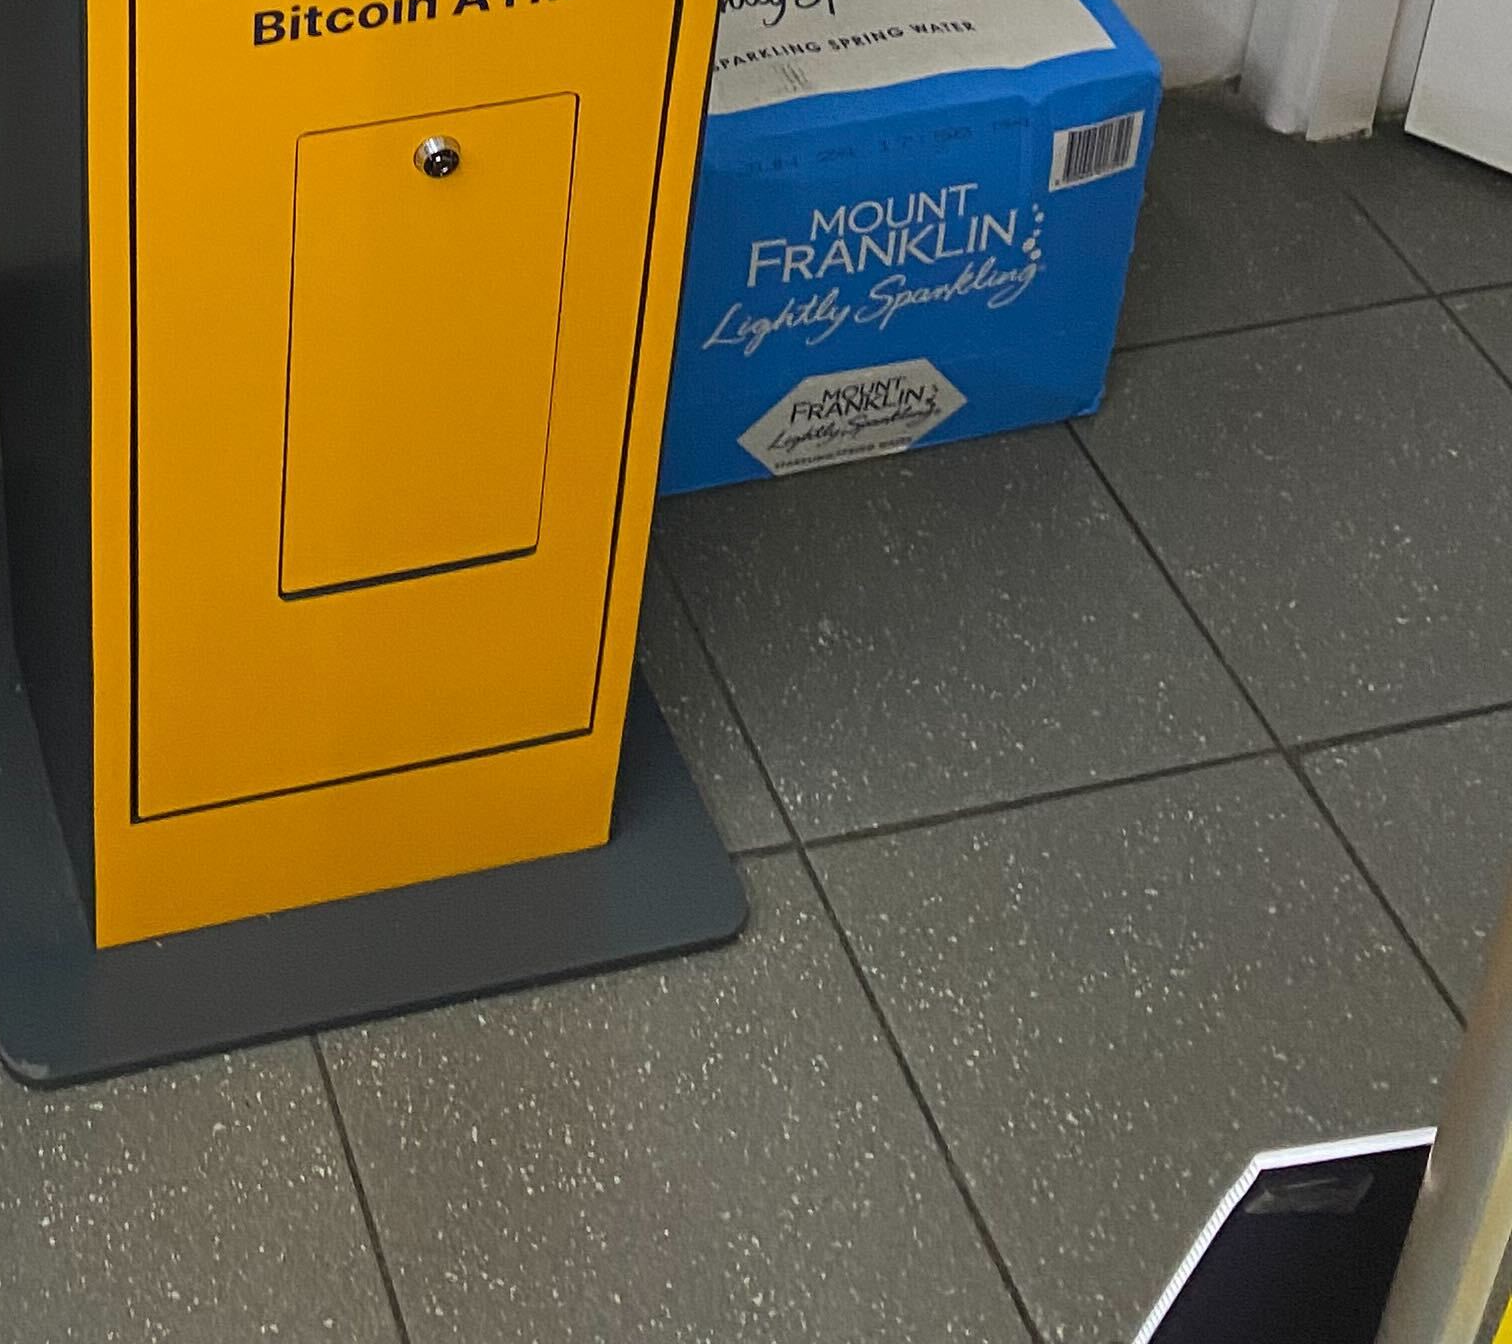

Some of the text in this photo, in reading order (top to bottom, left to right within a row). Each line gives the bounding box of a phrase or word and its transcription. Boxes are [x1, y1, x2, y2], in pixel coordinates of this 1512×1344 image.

[828, 26, 904, 50] SPRING
[910, 21, 976, 35] WATER
[810, 183, 978, 242] MOUNT
[747, 209, 1018, 288] FRANKLIN
[702, 257, 1038, 357] Lightly Sparkling
[791, 386, 925, 423] FRANKLIN
[823, 375, 906, 403] MOUNT
